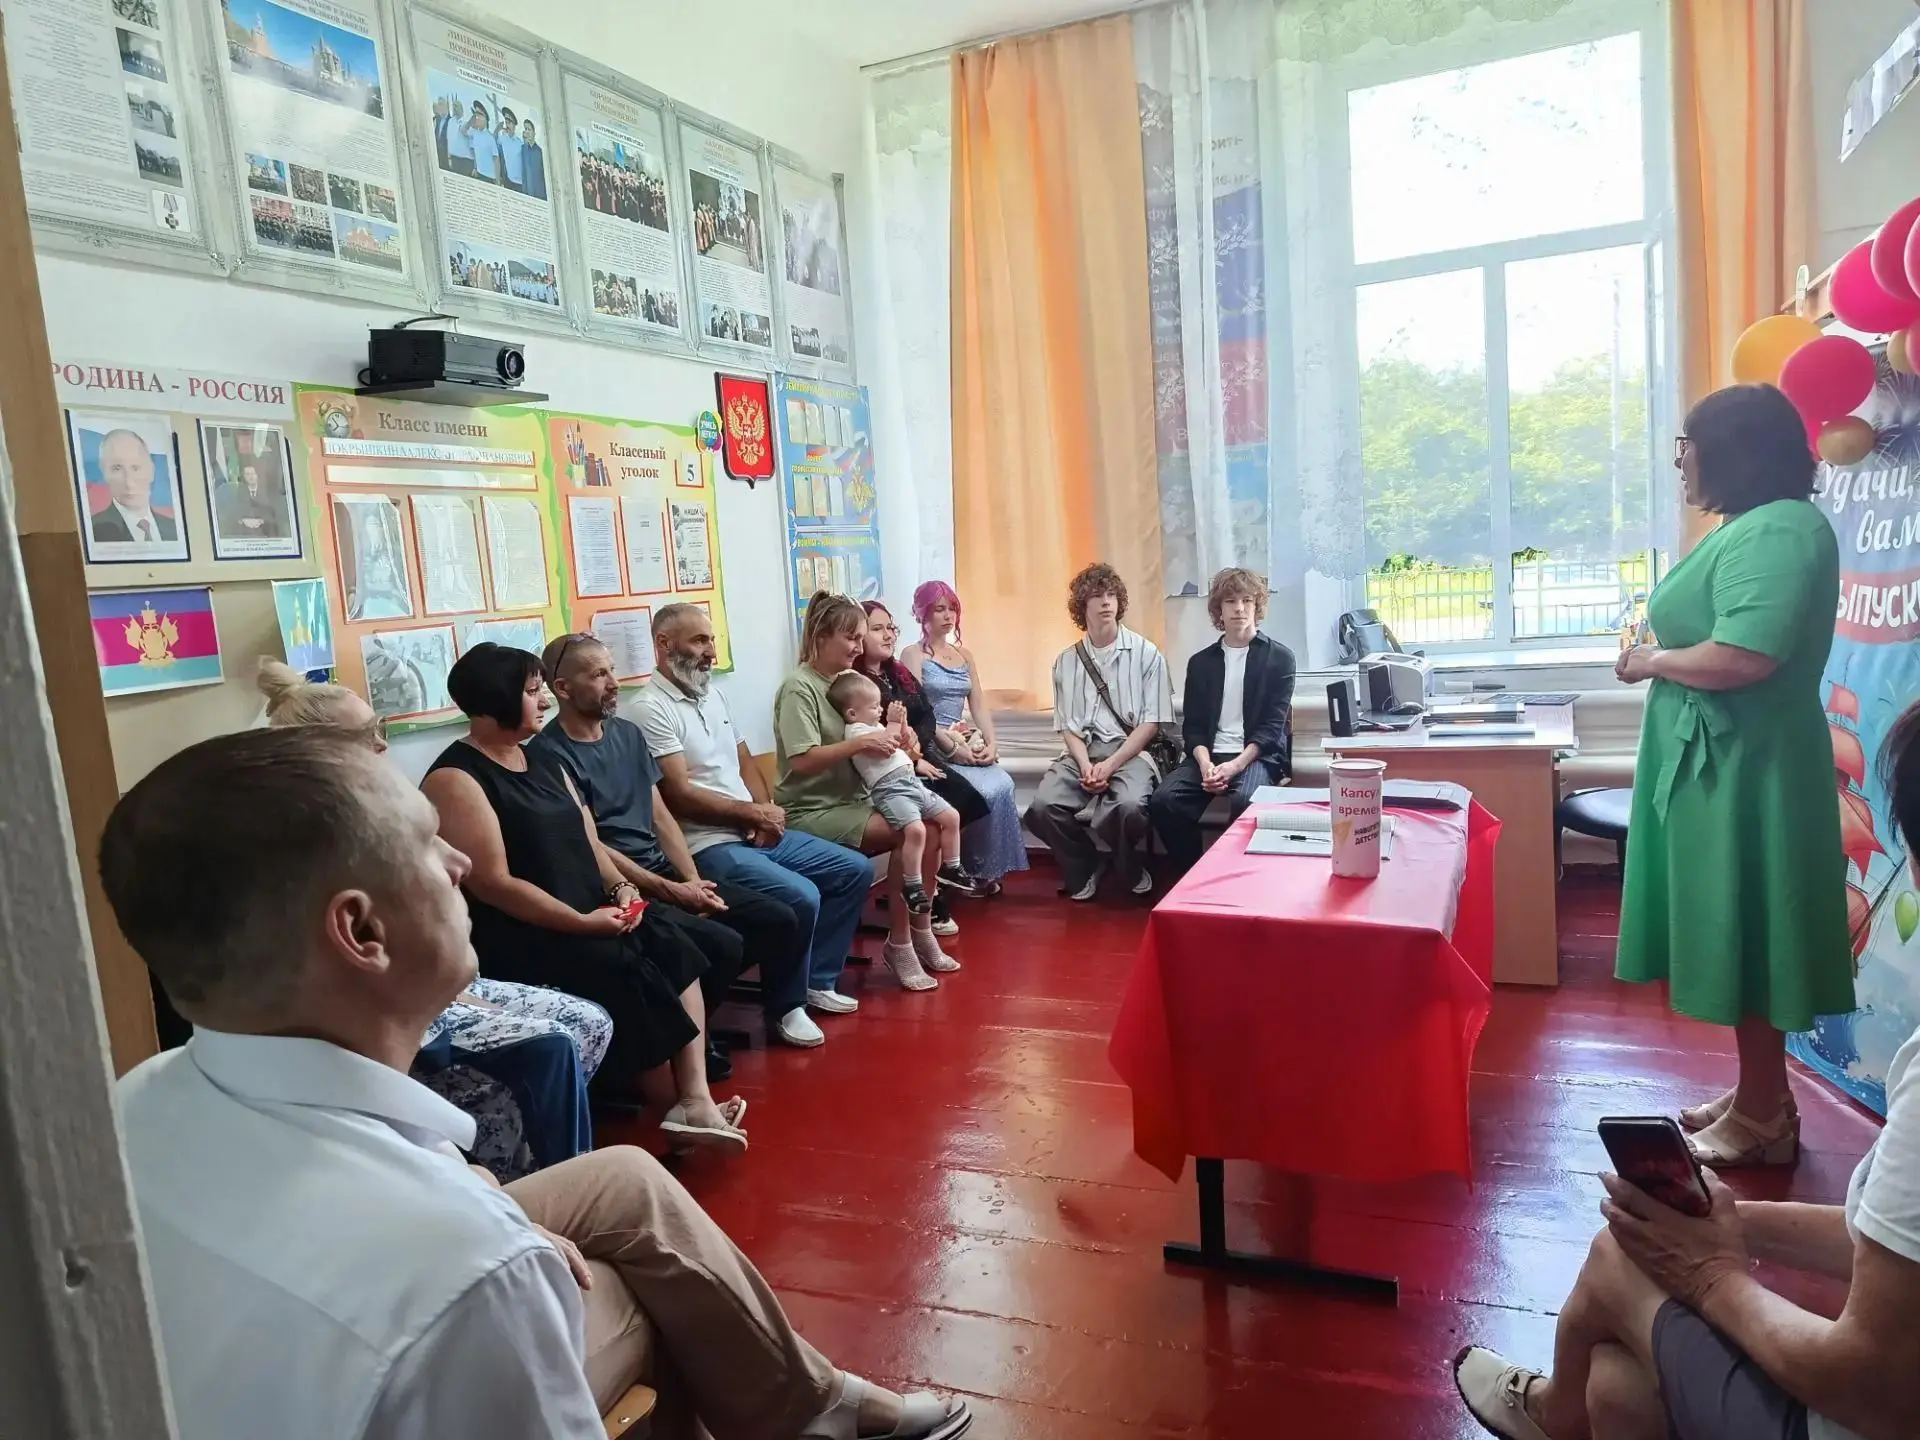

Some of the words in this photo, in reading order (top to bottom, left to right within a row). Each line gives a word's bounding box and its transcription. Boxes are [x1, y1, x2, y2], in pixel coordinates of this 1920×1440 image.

[188, 376, 285, 404] РОССИЯ
[378, 412, 429, 433] Класс
[435, 423, 488, 437] имени
[609, 442, 666, 460] Классный
[621, 466, 659, 479] уголок
[687, 464, 695, 481] 5
